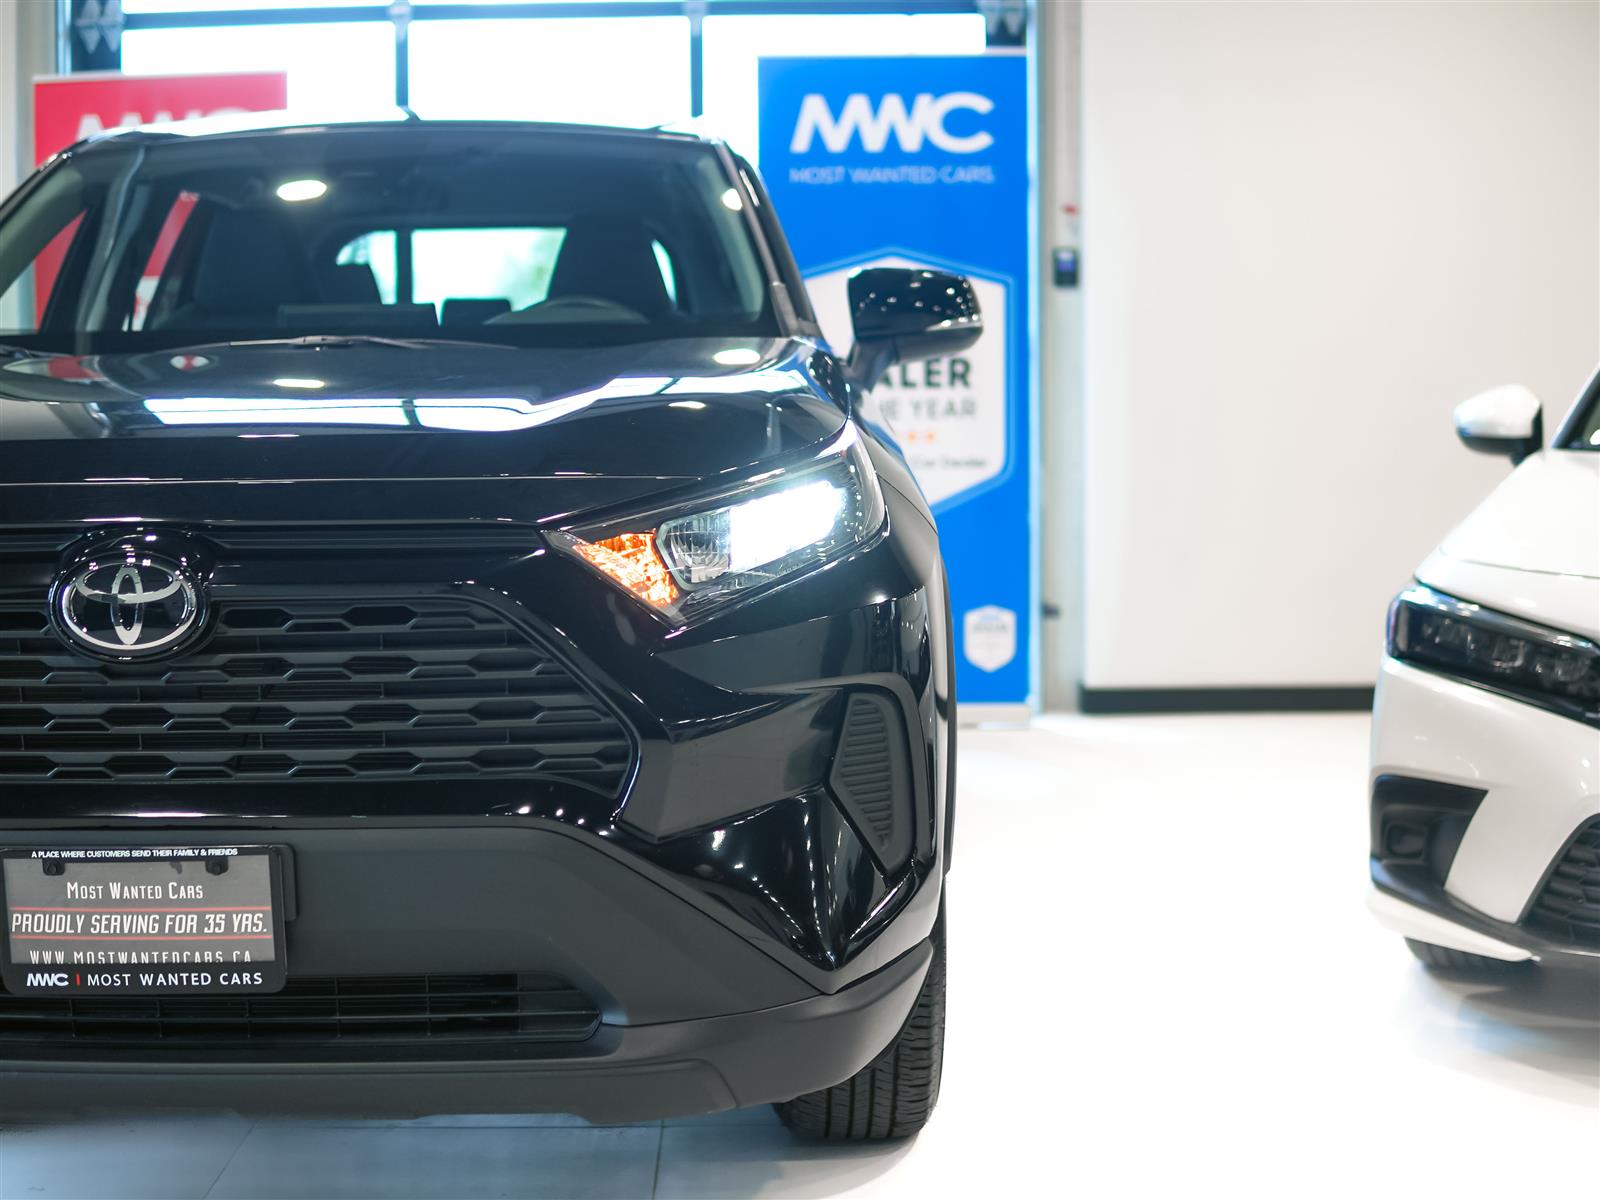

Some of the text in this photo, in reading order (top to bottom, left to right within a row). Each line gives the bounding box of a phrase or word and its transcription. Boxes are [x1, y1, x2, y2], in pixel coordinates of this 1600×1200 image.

[789, 92, 995, 153] MWC
[789, 165, 995, 184] MOST WANTED CARS
[31, 850, 38, 858] A
[38, 850, 60, 858] PLACE
[60, 850, 86, 858] WHERE
[86, 850, 131, 858] CUSTOMERS
[131, 849, 151, 857] SEND
[152, 849, 173, 857] THEIR
[173, 848, 200, 857] FAMILY
[208, 848, 238, 856] FRIENDS
[11, 913, 268, 934] PROUDLY SERVING FOR 35 YRS.
[26, 972, 263, 987] MWC MOST WANTED CARS
